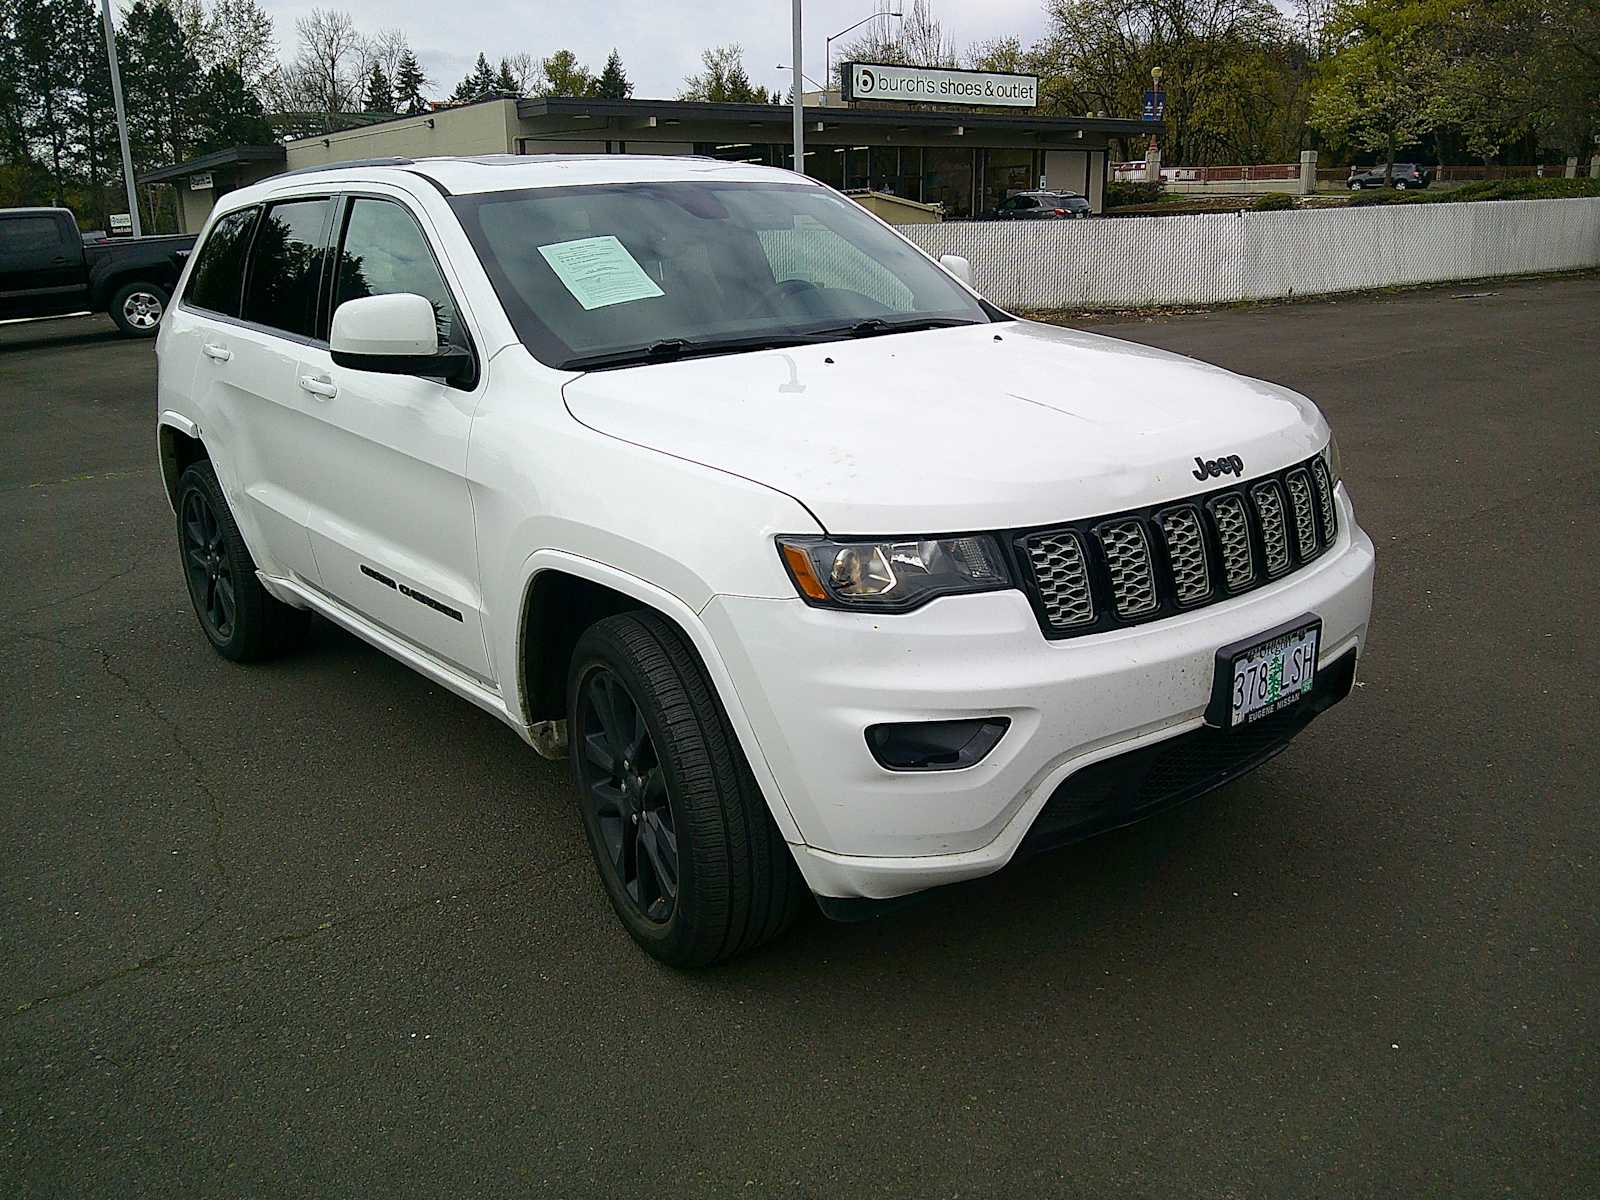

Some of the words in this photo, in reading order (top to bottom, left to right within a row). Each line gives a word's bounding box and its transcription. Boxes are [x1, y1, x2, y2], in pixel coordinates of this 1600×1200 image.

[878, 73, 935, 93] burch's
[939, 78, 982, 96] shoes
[984, 80, 994, 97] &
[997, 83, 1034, 99] outlet
[1192, 454, 1244, 482] Jeep
[1234, 661, 1268, 710] 378
[1280, 641, 1315, 691] LSH
[1248, 703, 1275, 723] EUGENE
[1276, 692, 1301, 708] NISSAN
